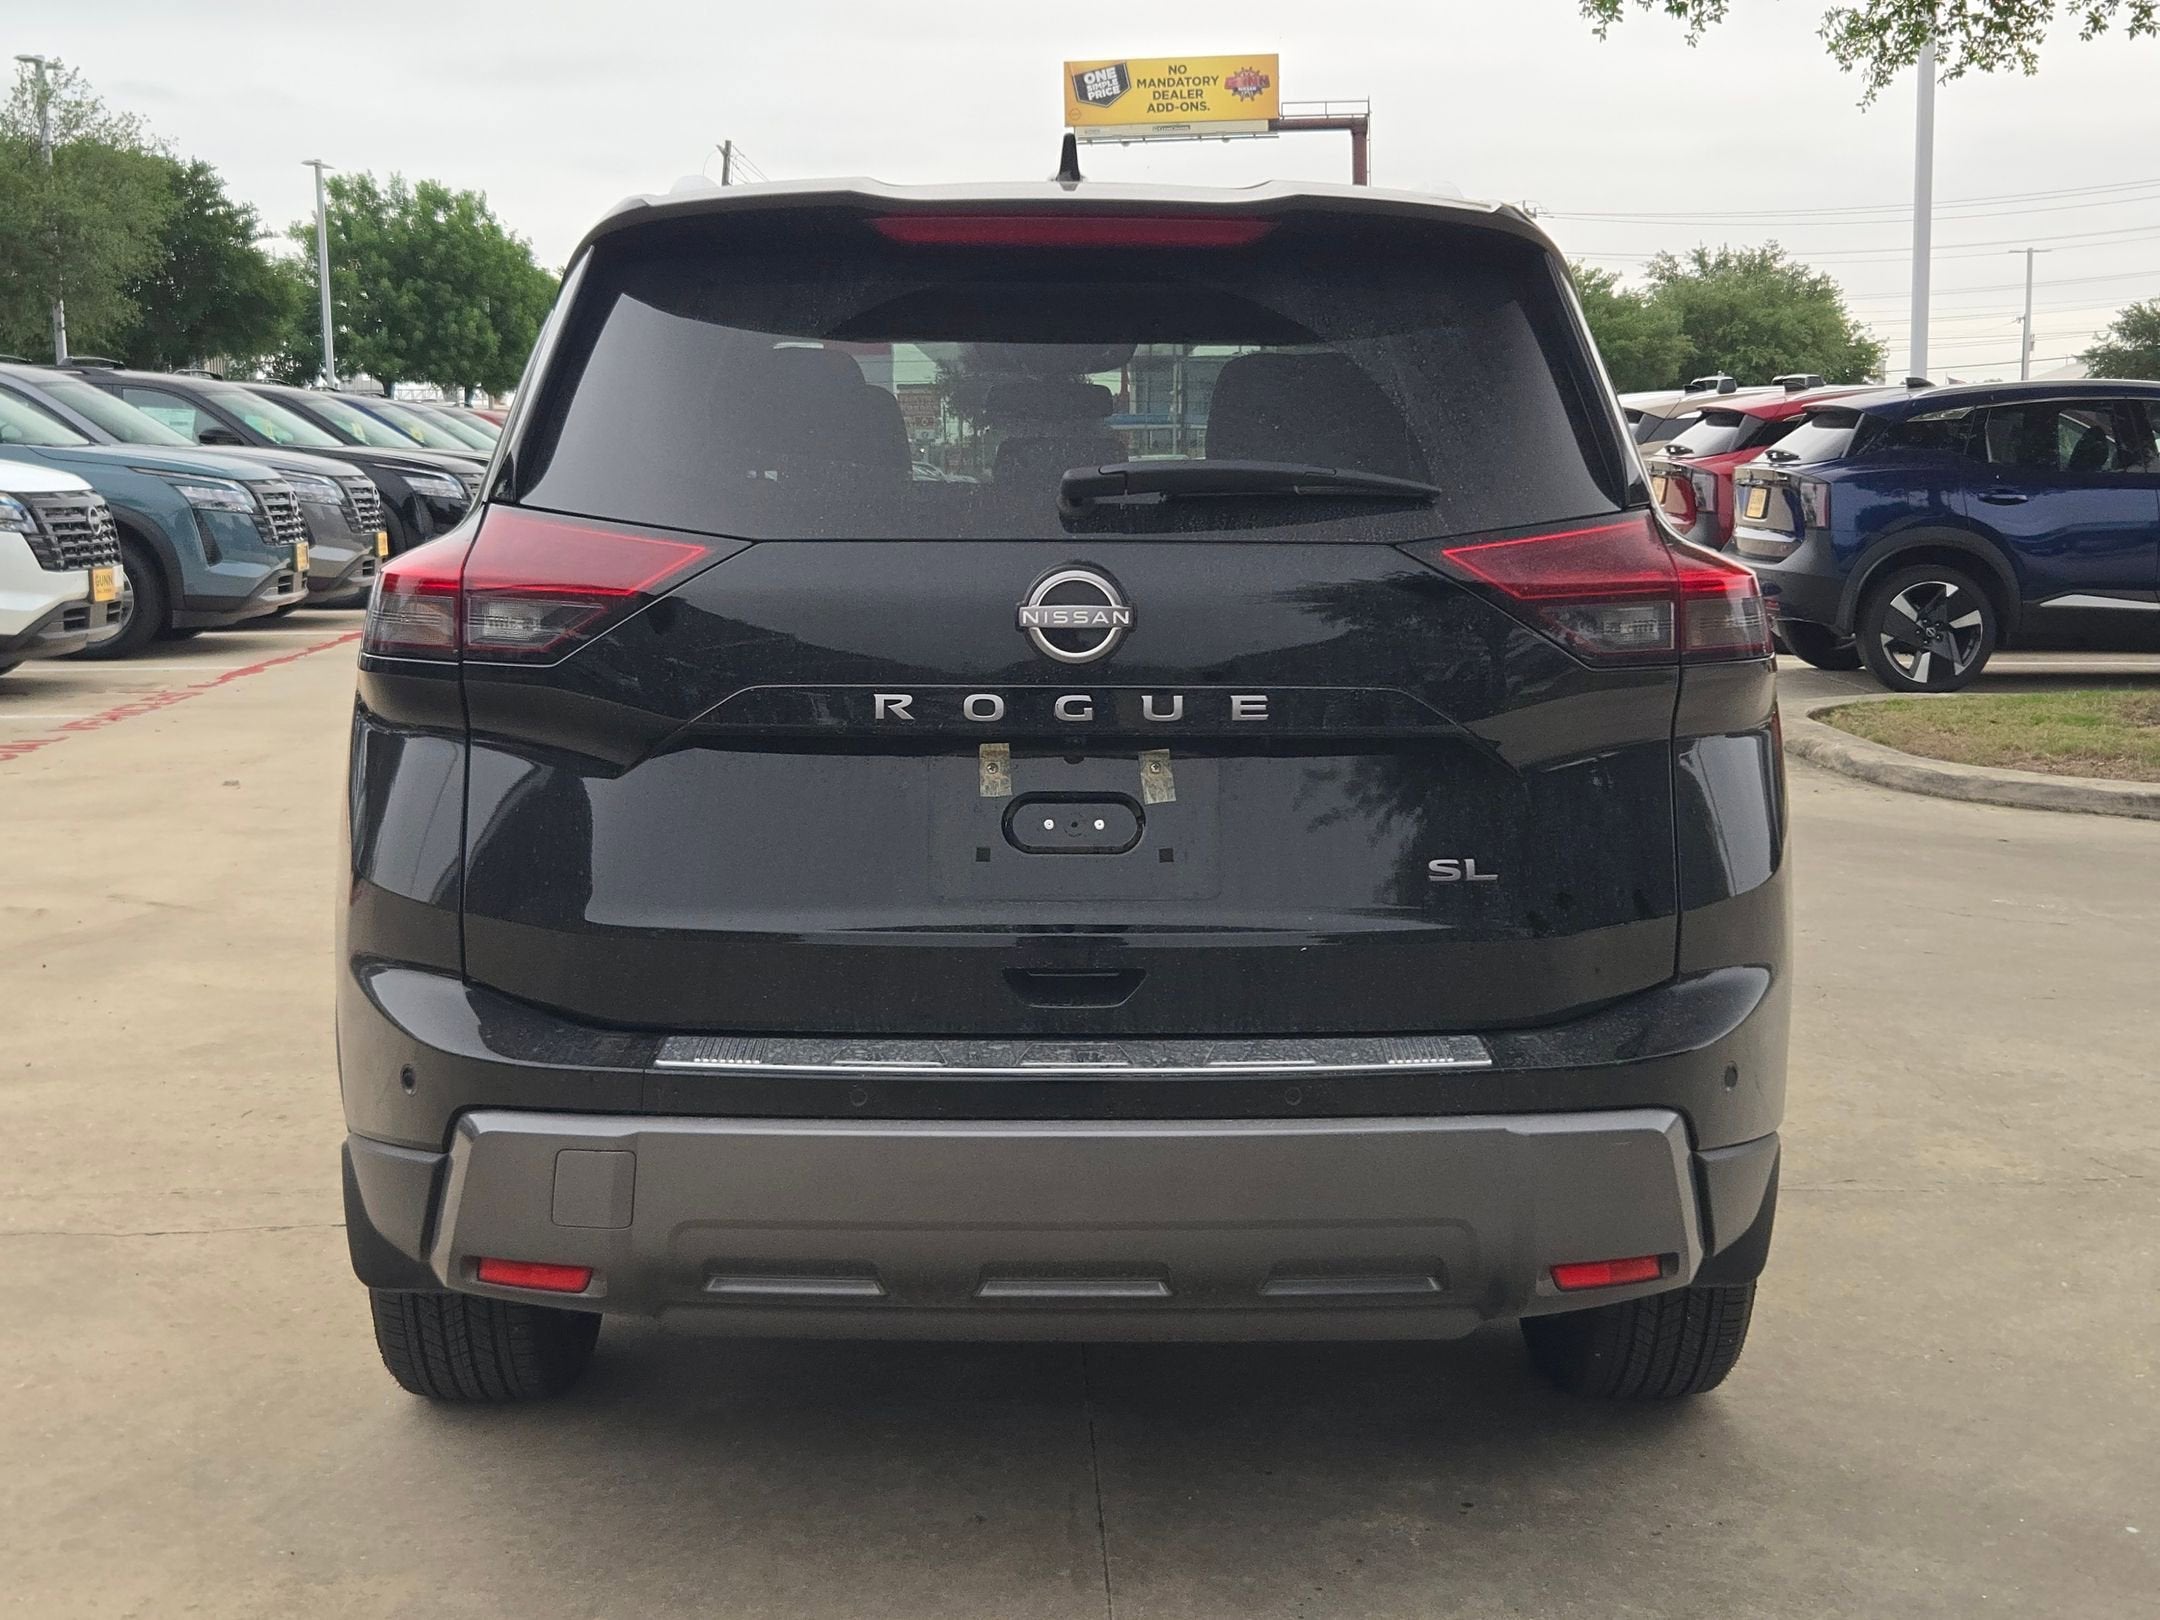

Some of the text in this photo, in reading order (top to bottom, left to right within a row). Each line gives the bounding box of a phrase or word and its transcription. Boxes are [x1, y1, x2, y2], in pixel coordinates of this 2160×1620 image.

[1083, 67, 1118, 85] ONE
[1168, 64, 1188, 75] NO
[1136, 75, 1220, 89] MANDATORY
[1088, 85, 1121, 101] PRICE
[1152, 88, 1204, 101] DEALER
[1146, 101, 1211, 114] ADD-ONS.
[1022, 610, 1130, 624] NISSAN
[873, 693, 1269, 722] ROGUE
[1428, 858, 1499, 881] SL
